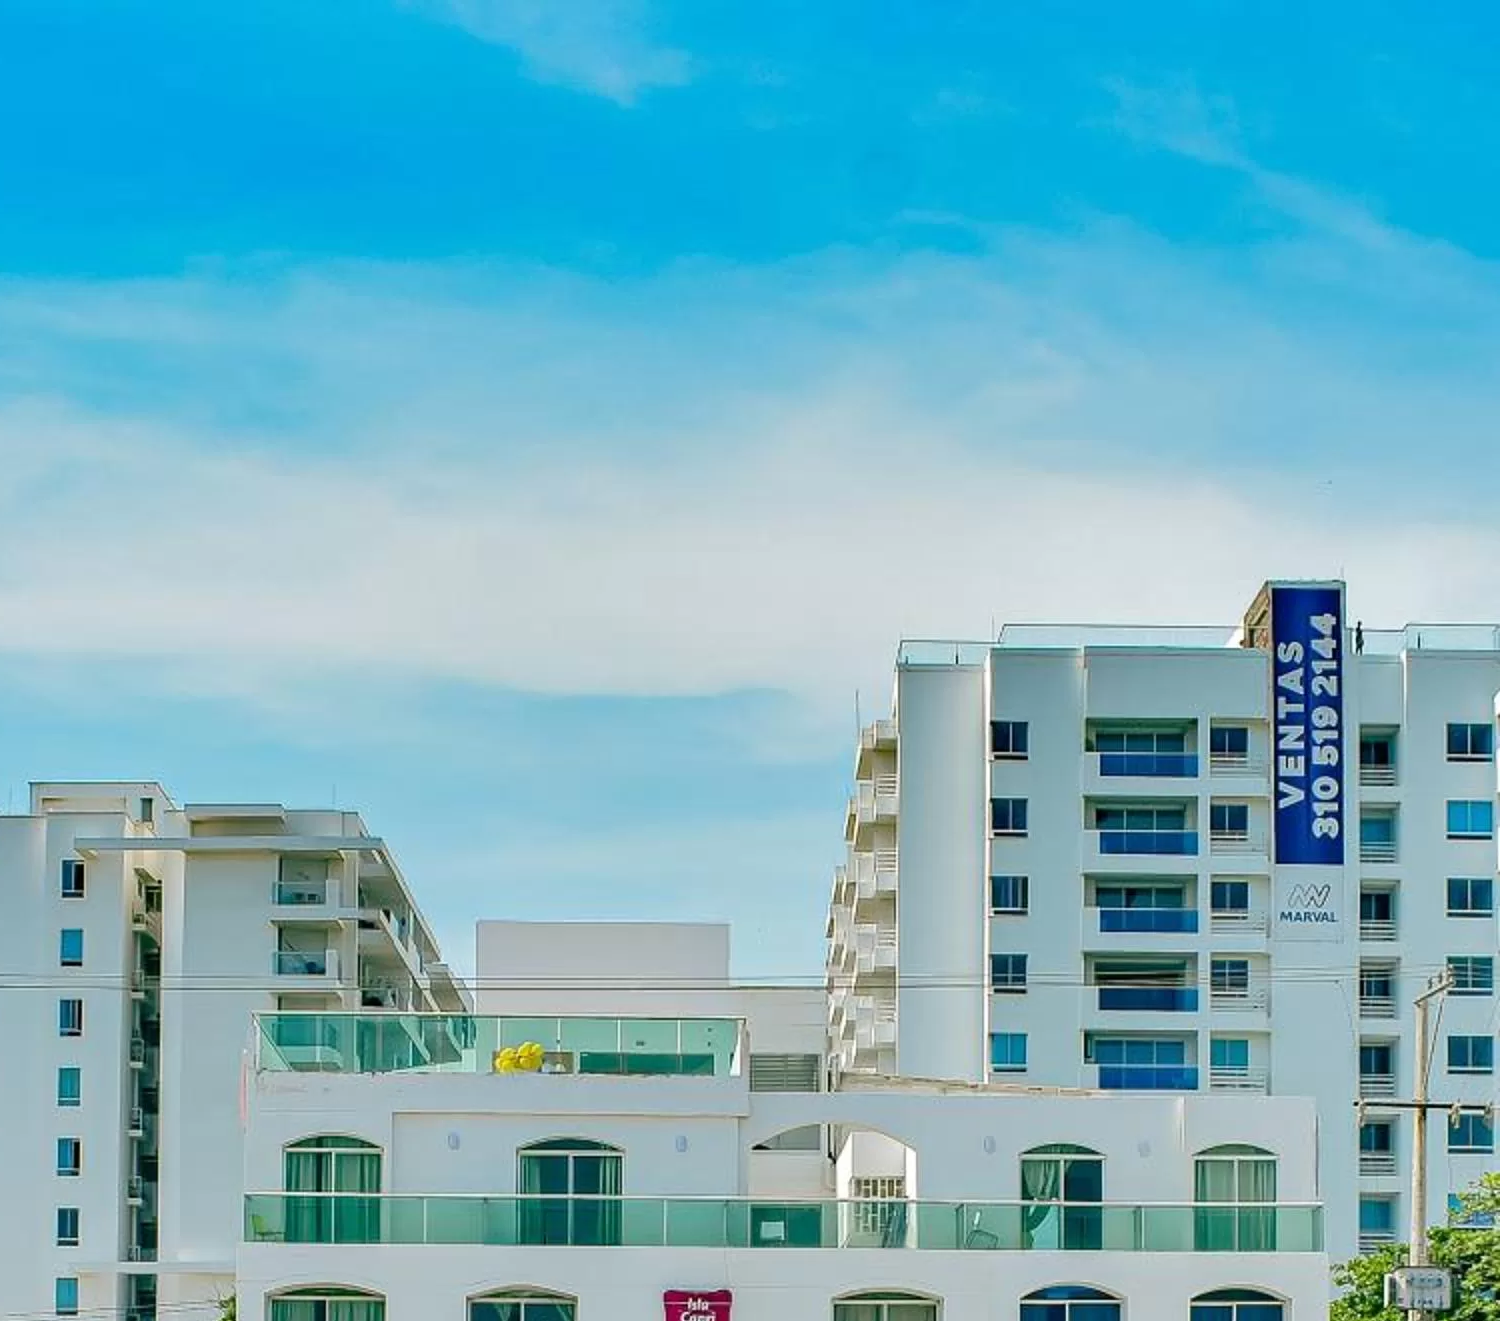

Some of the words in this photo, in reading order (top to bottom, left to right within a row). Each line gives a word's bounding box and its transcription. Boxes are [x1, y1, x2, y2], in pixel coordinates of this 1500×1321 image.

[1309, 613, 1338, 697] 2144
[1277, 641, 1305, 809] VENTAS
[1311, 705, 1339, 767] 519
[1311, 776, 1339, 839] 310
[1279, 911, 1339, 923] MARVAL
[687, 1297, 709, 1311] Isla
